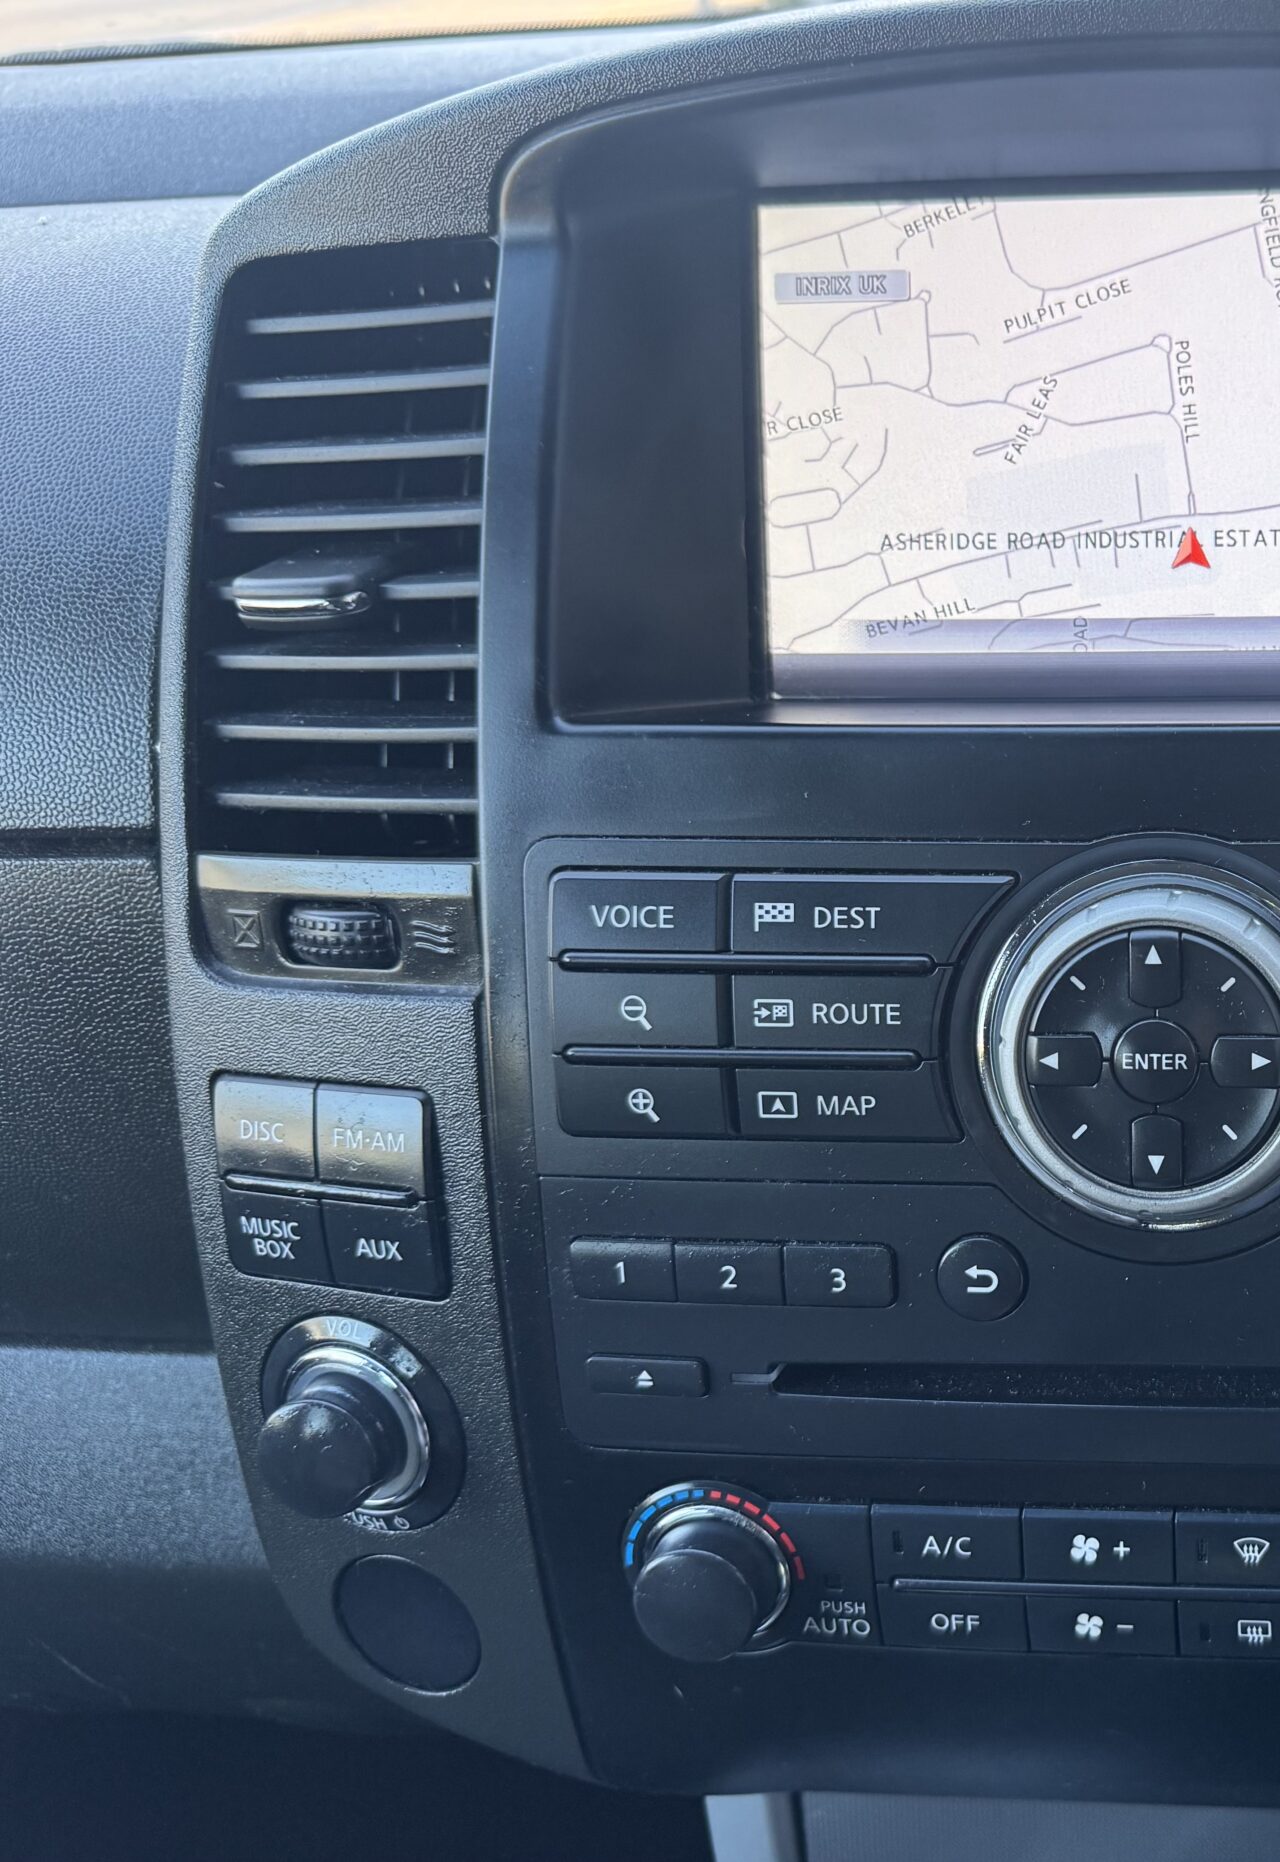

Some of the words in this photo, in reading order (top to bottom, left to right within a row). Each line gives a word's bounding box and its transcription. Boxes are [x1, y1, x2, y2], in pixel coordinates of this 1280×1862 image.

[796, 275, 851, 297] INRIX
[858, 274, 887, 296] UK
[1003, 301, 1066, 334] PULPIT
[1075, 277, 1132, 310] CLOSE
[1174, 340, 1195, 396] POLES
[786, 407, 844, 431] CLOSE
[1004, 423, 1034, 465] FAIR
[1026, 375, 1058, 420] LEAS
[1182, 403, 1200, 444] HILL
[880, 532, 997, 551] ASHERIDGE
[1007, 531, 1065, 550] ROAD
[866, 608, 929, 639] BEVAN
[934, 598, 976, 621] HILL
[591, 904, 674, 929] VOICE
[813, 906, 881, 930] DEST
[812, 1003, 901, 1025] ROUTE
[1122, 1053, 1188, 1070] ENTER
[816, 1095, 876, 1117] MAP
[240, 1119, 284, 1143] DISC
[240, 1215, 300, 1240] MUSIC
[254, 1238, 295, 1260] BOX
[356, 1238, 403, 1262] AUX
[615, 1261, 626, 1285] 1
[719, 1265, 737, 1289] 2
[830, 1268, 847, 1293] 3
[326, 1319, 361, 1340] VOL
[352, 1511, 388, 1530] USH
[921, 1535, 972, 1558] A/C
[821, 1600, 866, 1616] PUSH
[803, 1616, 871, 1636] AUTO
[931, 1612, 980, 1633] OFF
